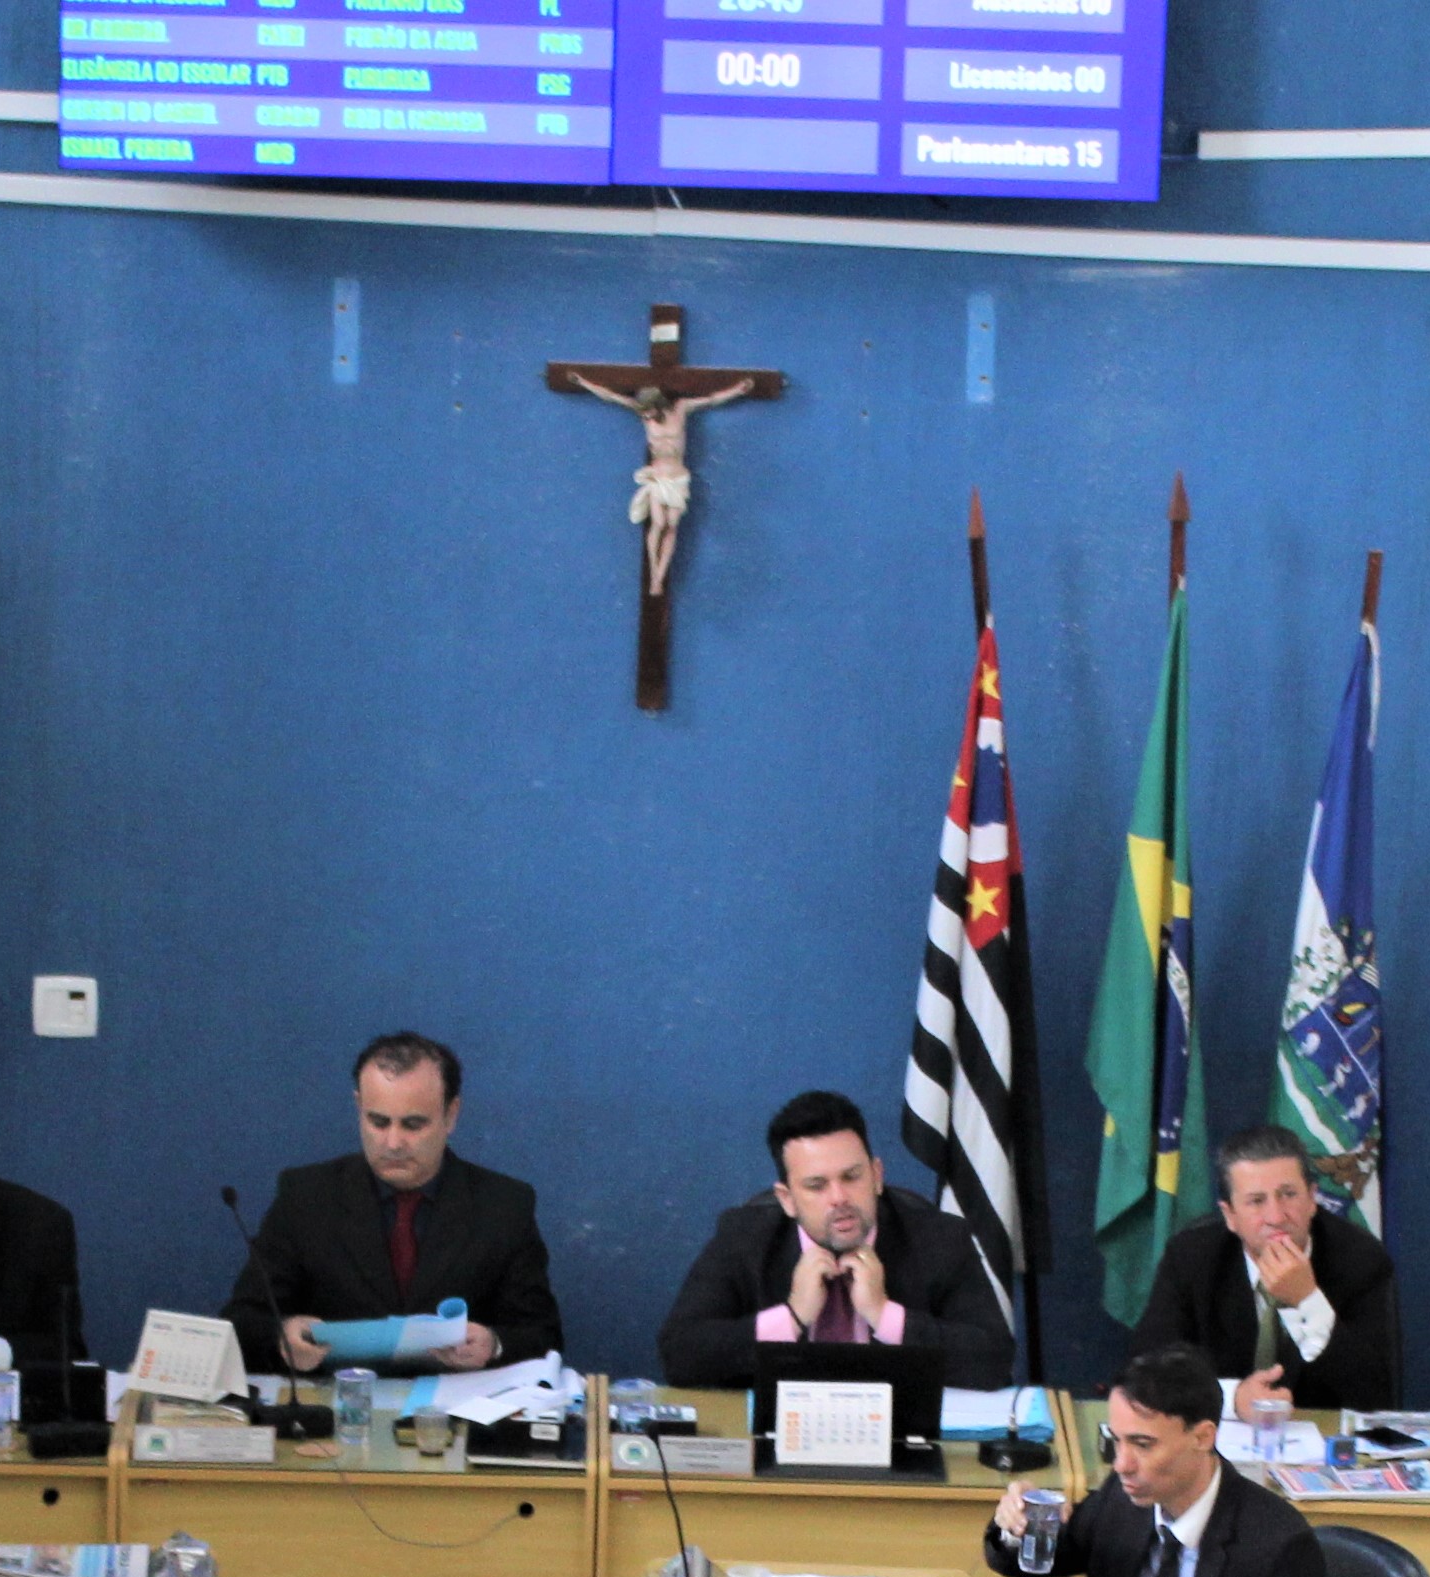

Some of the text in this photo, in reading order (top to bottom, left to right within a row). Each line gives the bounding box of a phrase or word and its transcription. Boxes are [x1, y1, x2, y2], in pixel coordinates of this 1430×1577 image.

[718, 53, 799, 87] 00:00
[950, 62, 1105, 93] Licenciados 00
[917, 135, 1102, 167] Parlamentares 15
